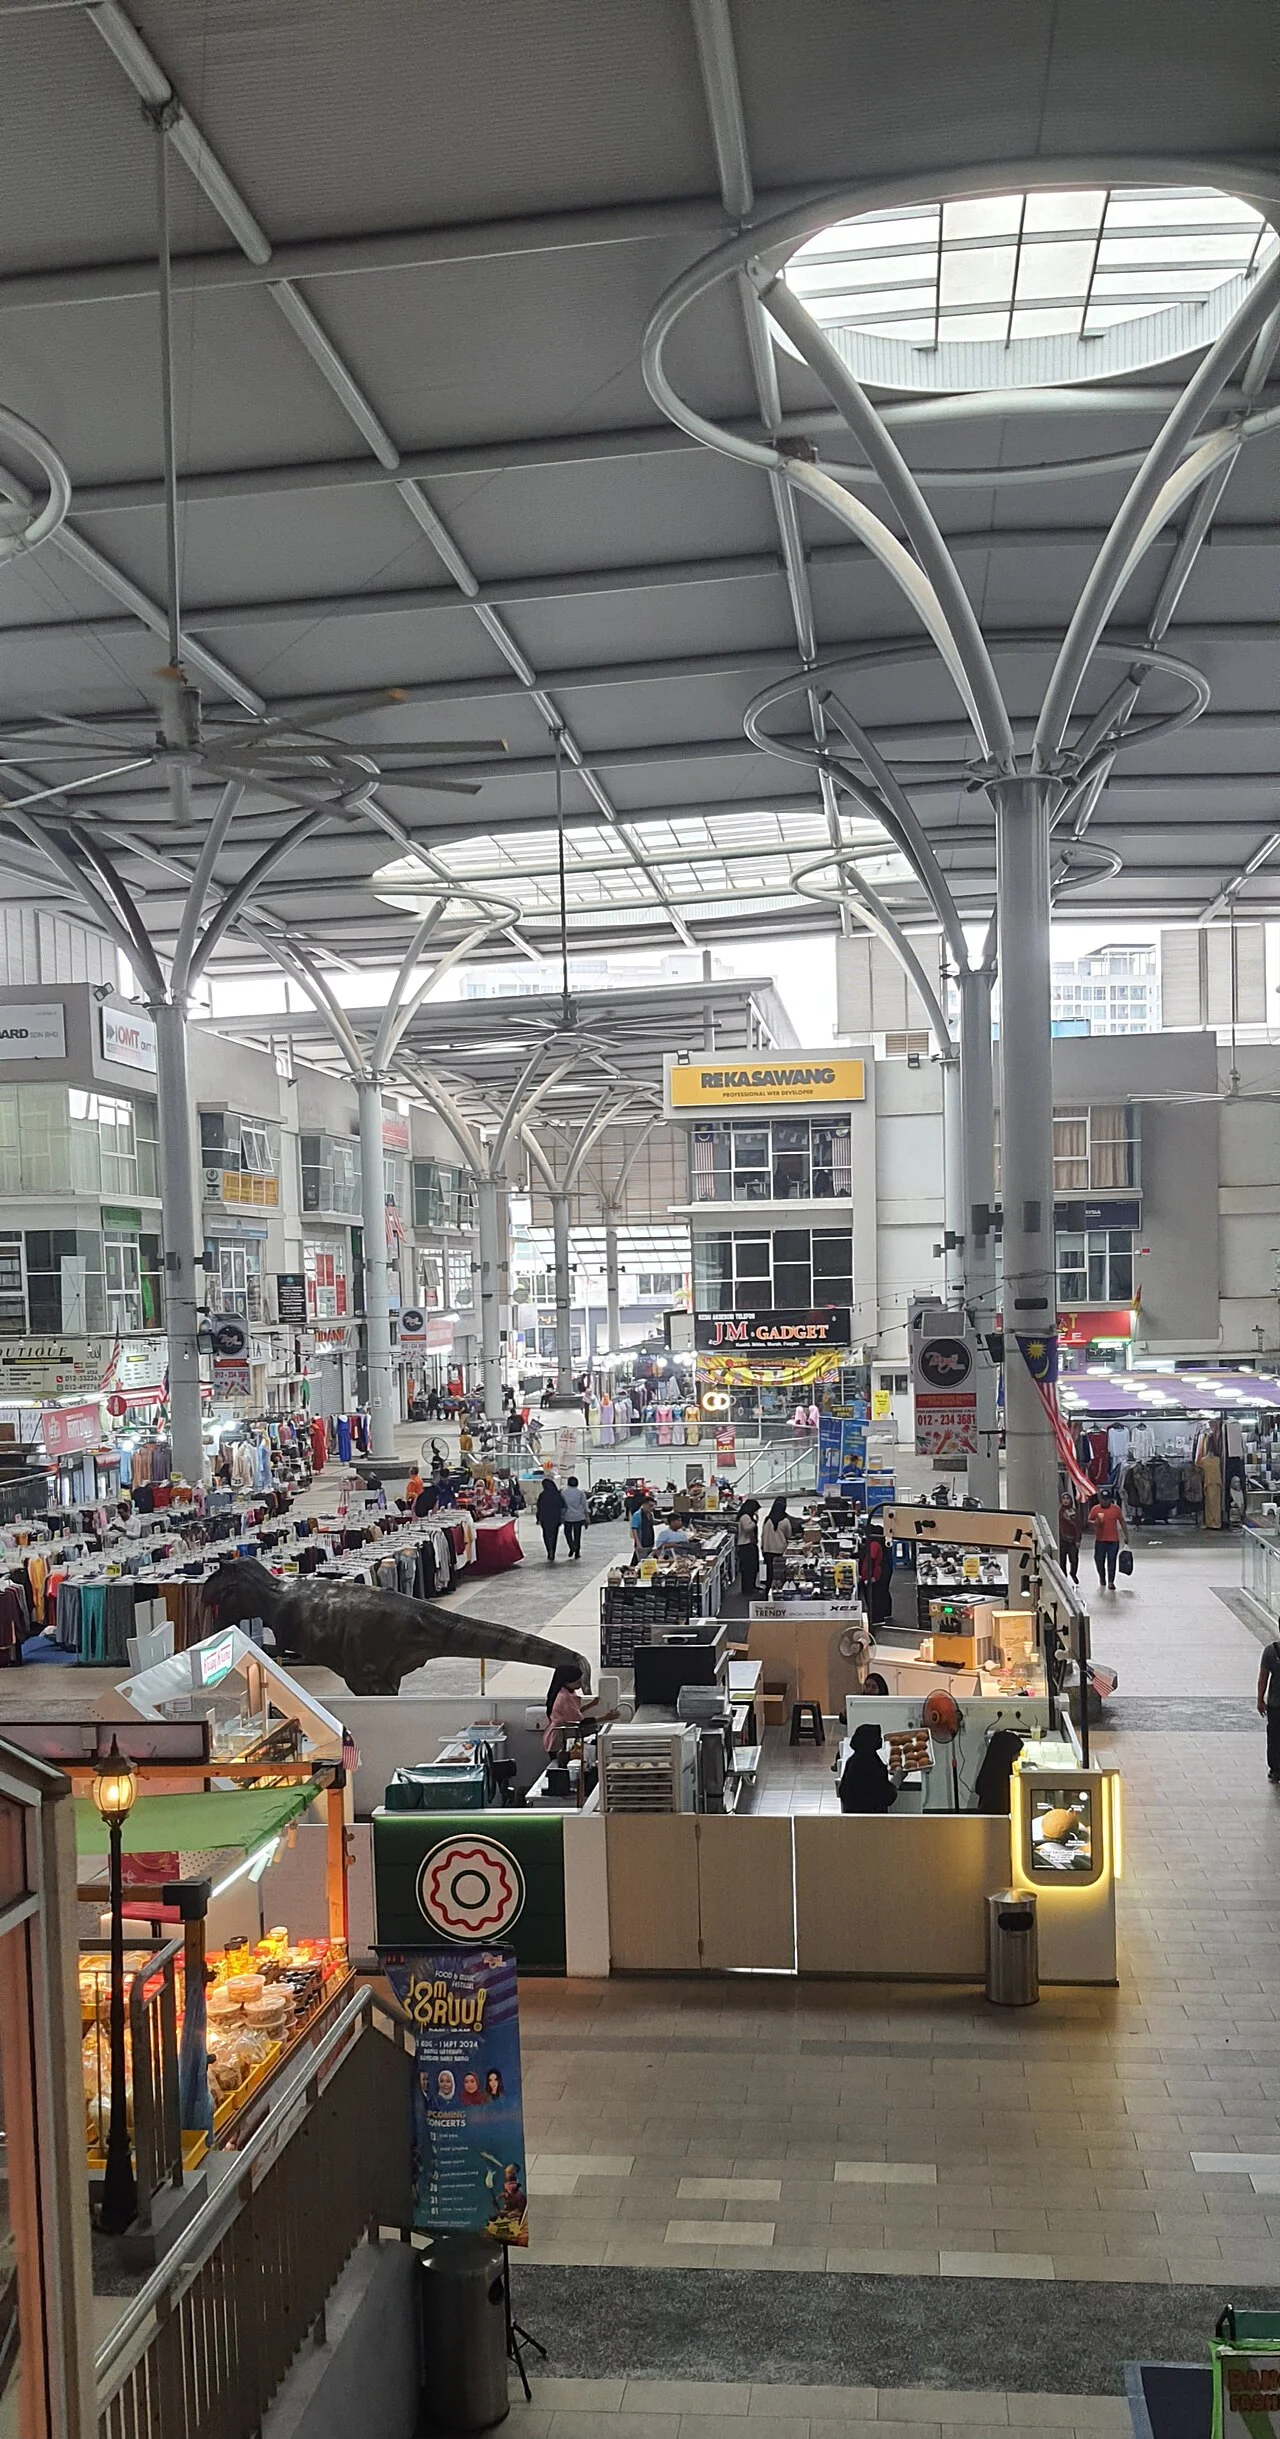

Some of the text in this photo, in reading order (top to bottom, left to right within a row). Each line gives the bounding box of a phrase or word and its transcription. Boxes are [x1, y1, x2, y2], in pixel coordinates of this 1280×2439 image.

[0, 1029, 28, 1039] ARD
[701, 1068, 836, 1089] REKASAWANG
[709, 1321, 829, 1346] JM GADGET
[917, 1414, 932, 1426] 012
[940, 1414, 954, 1426] 234
[957, 1413, 976, 1425] 3681
[755, 1609, 786, 1617] TRENDY
[435, 1970, 452, 1979] FOOD
[459, 2040, 479, 2048] 2024
